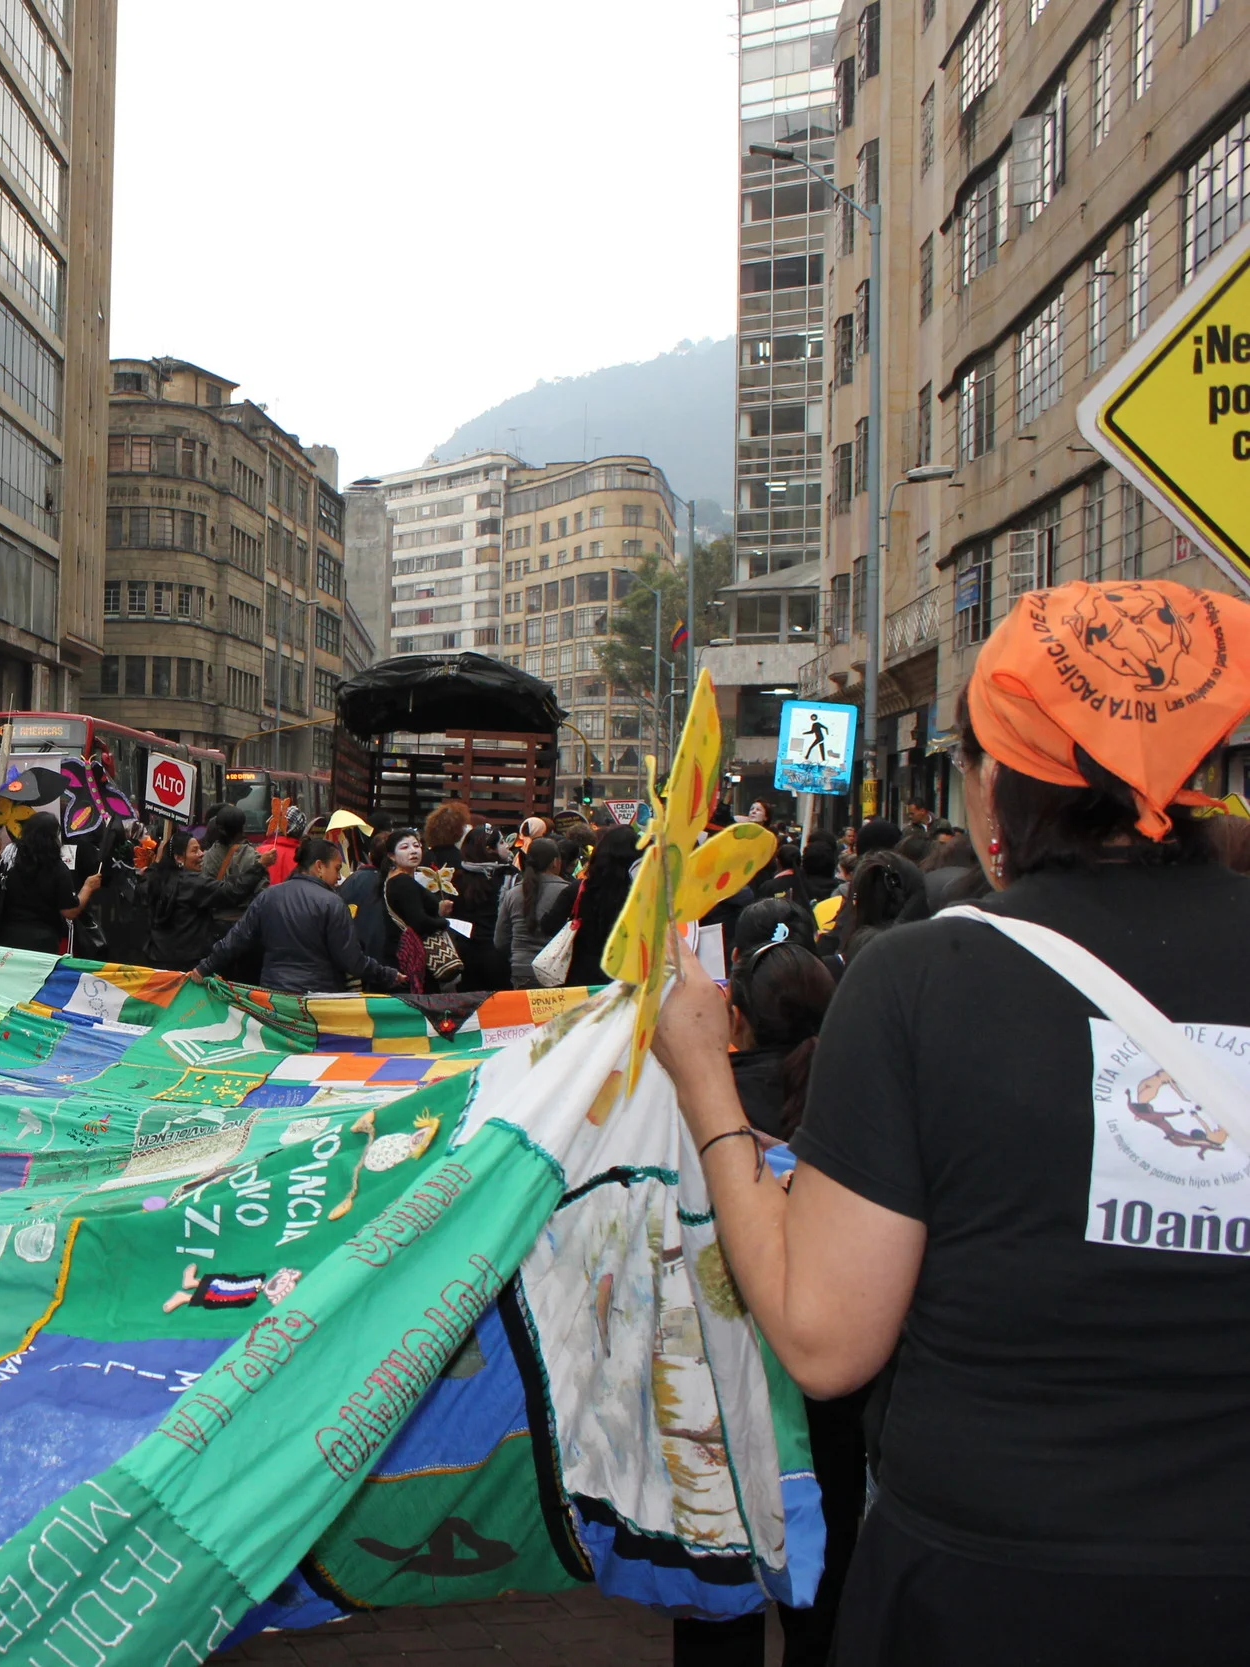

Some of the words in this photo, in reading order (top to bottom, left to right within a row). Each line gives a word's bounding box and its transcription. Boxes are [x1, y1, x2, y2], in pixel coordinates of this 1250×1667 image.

[1046, 634, 1101, 711] PACÍFICA
[1109, 698, 1157, 723] RUTA
[20, 726, 63, 737] AMERICAS
[155, 773, 184, 796] ALTO
[1095, 1068, 1118, 1103] RUTA
[1110, 1035, 1143, 1068] PACÍ
[138, 1126, 199, 1148] VIOLENCIA
[1106, 1118, 1117, 1134] Las
[1112, 1133, 1141, 1163] mujeres
[1139, 1158, 1150, 1171] no
[1150, 1165, 1186, 1186] parimos
